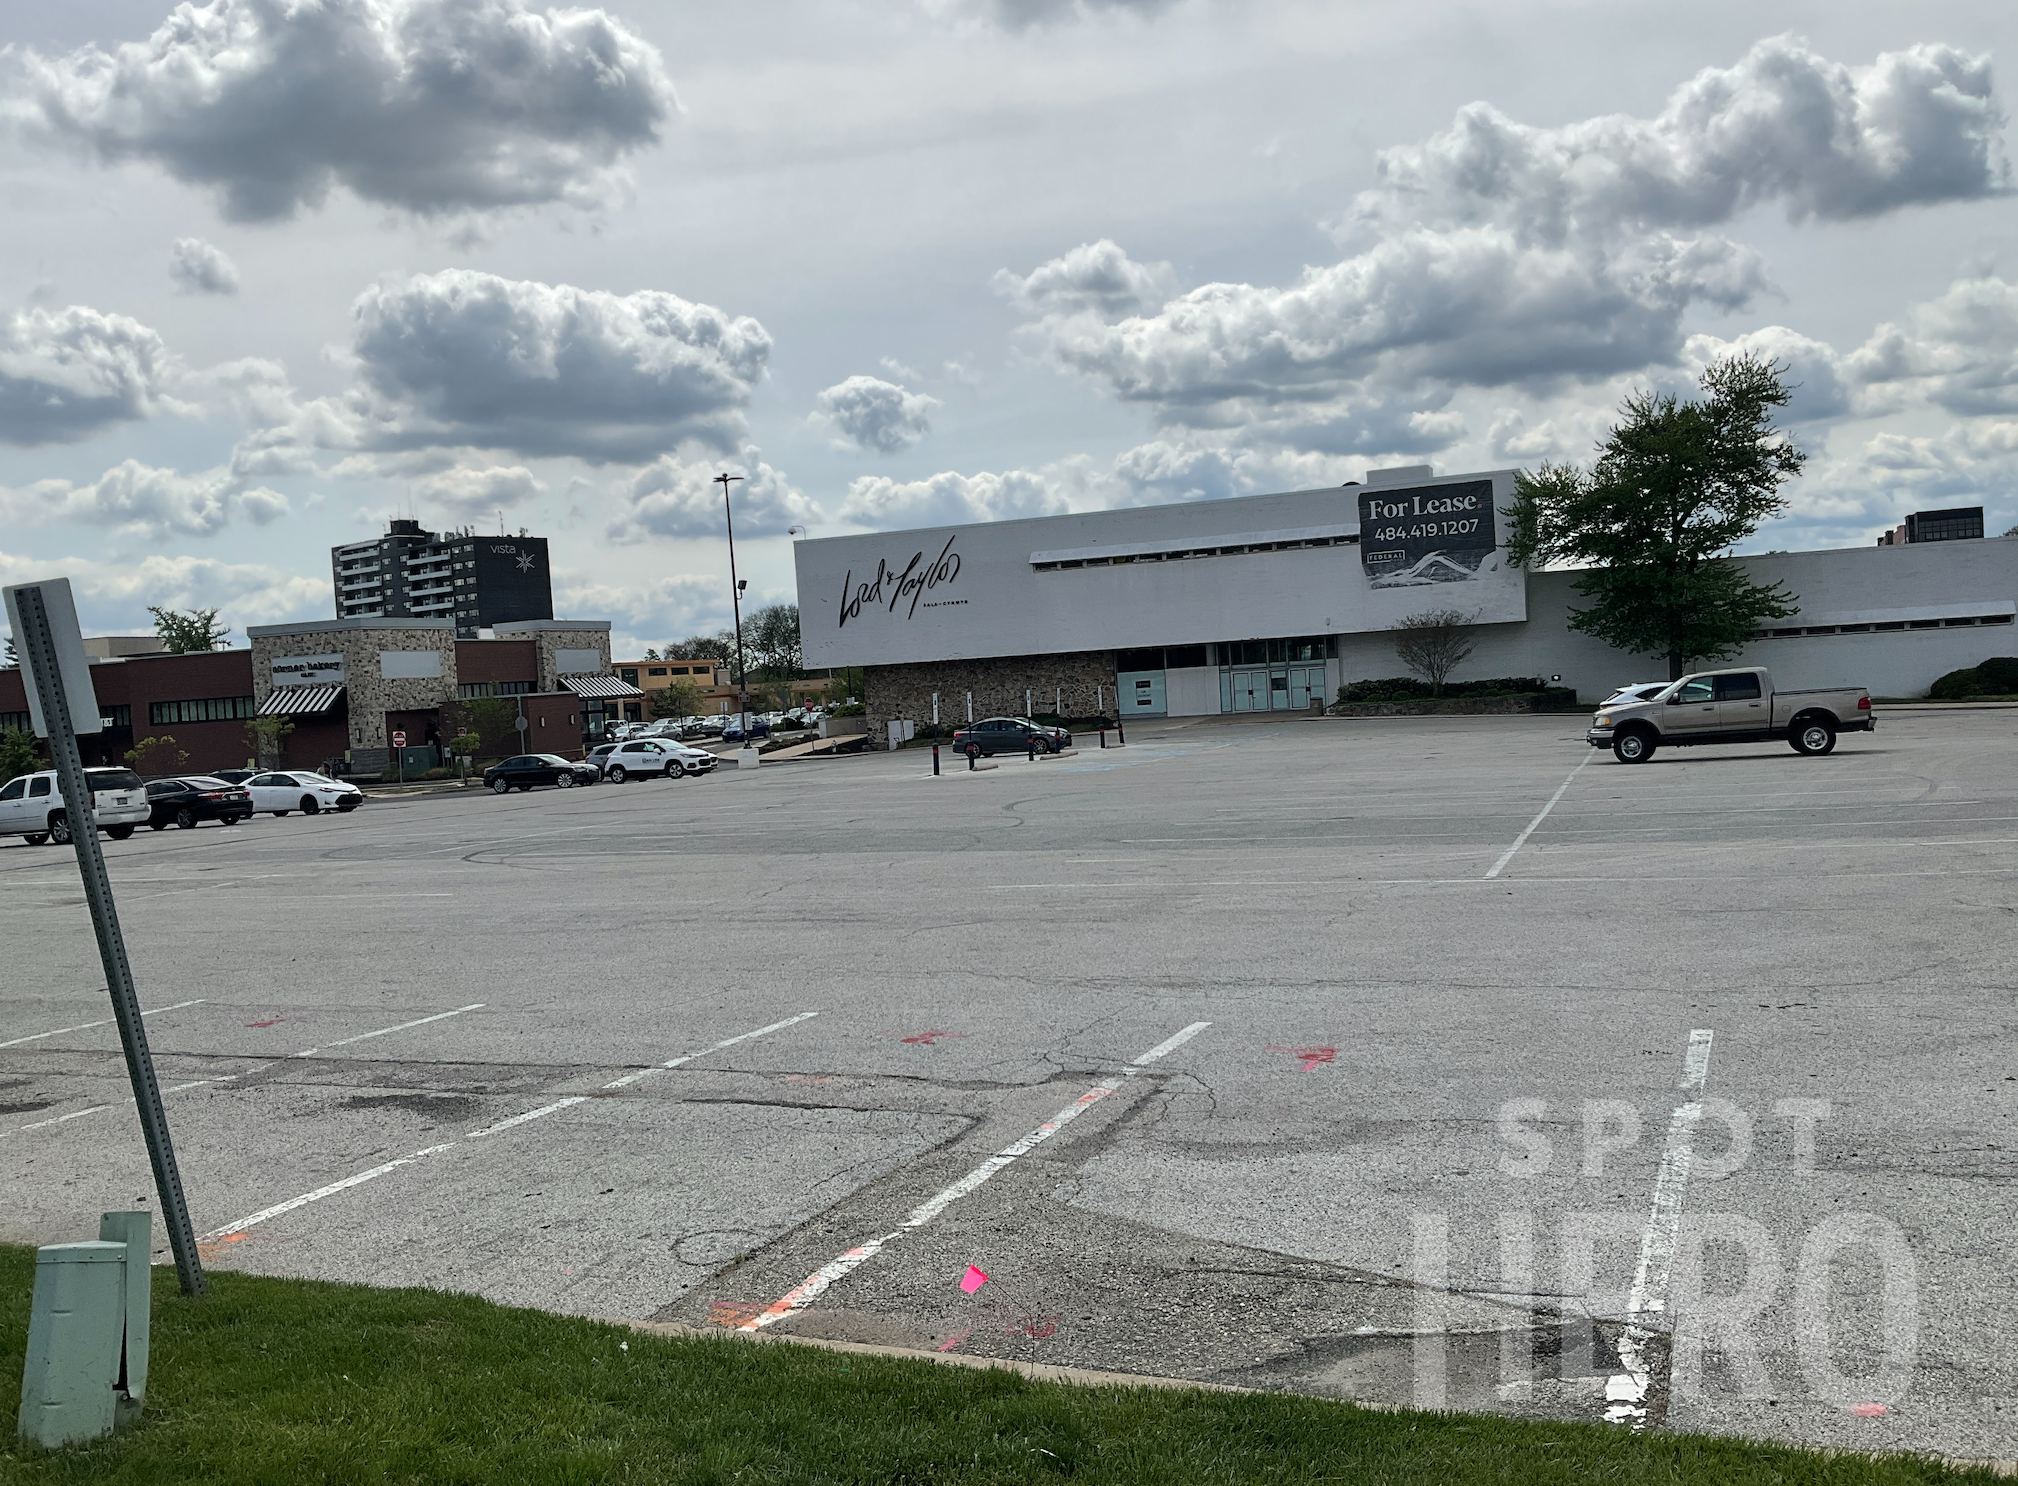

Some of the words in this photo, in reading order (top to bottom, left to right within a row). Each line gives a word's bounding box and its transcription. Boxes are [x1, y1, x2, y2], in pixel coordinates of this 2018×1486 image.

[1369, 500, 1408, 520] For
[1412, 495, 1482, 516] Lease.
[1375, 518, 1479, 541] 484.419.1207
[490, 544, 517, 554] vista
[1369, 552, 1403, 561] FEDERAL
[839, 558, 885, 628] Lord
[889, 534, 961, 620] Taylor
[307, 662, 342, 671] bakery
